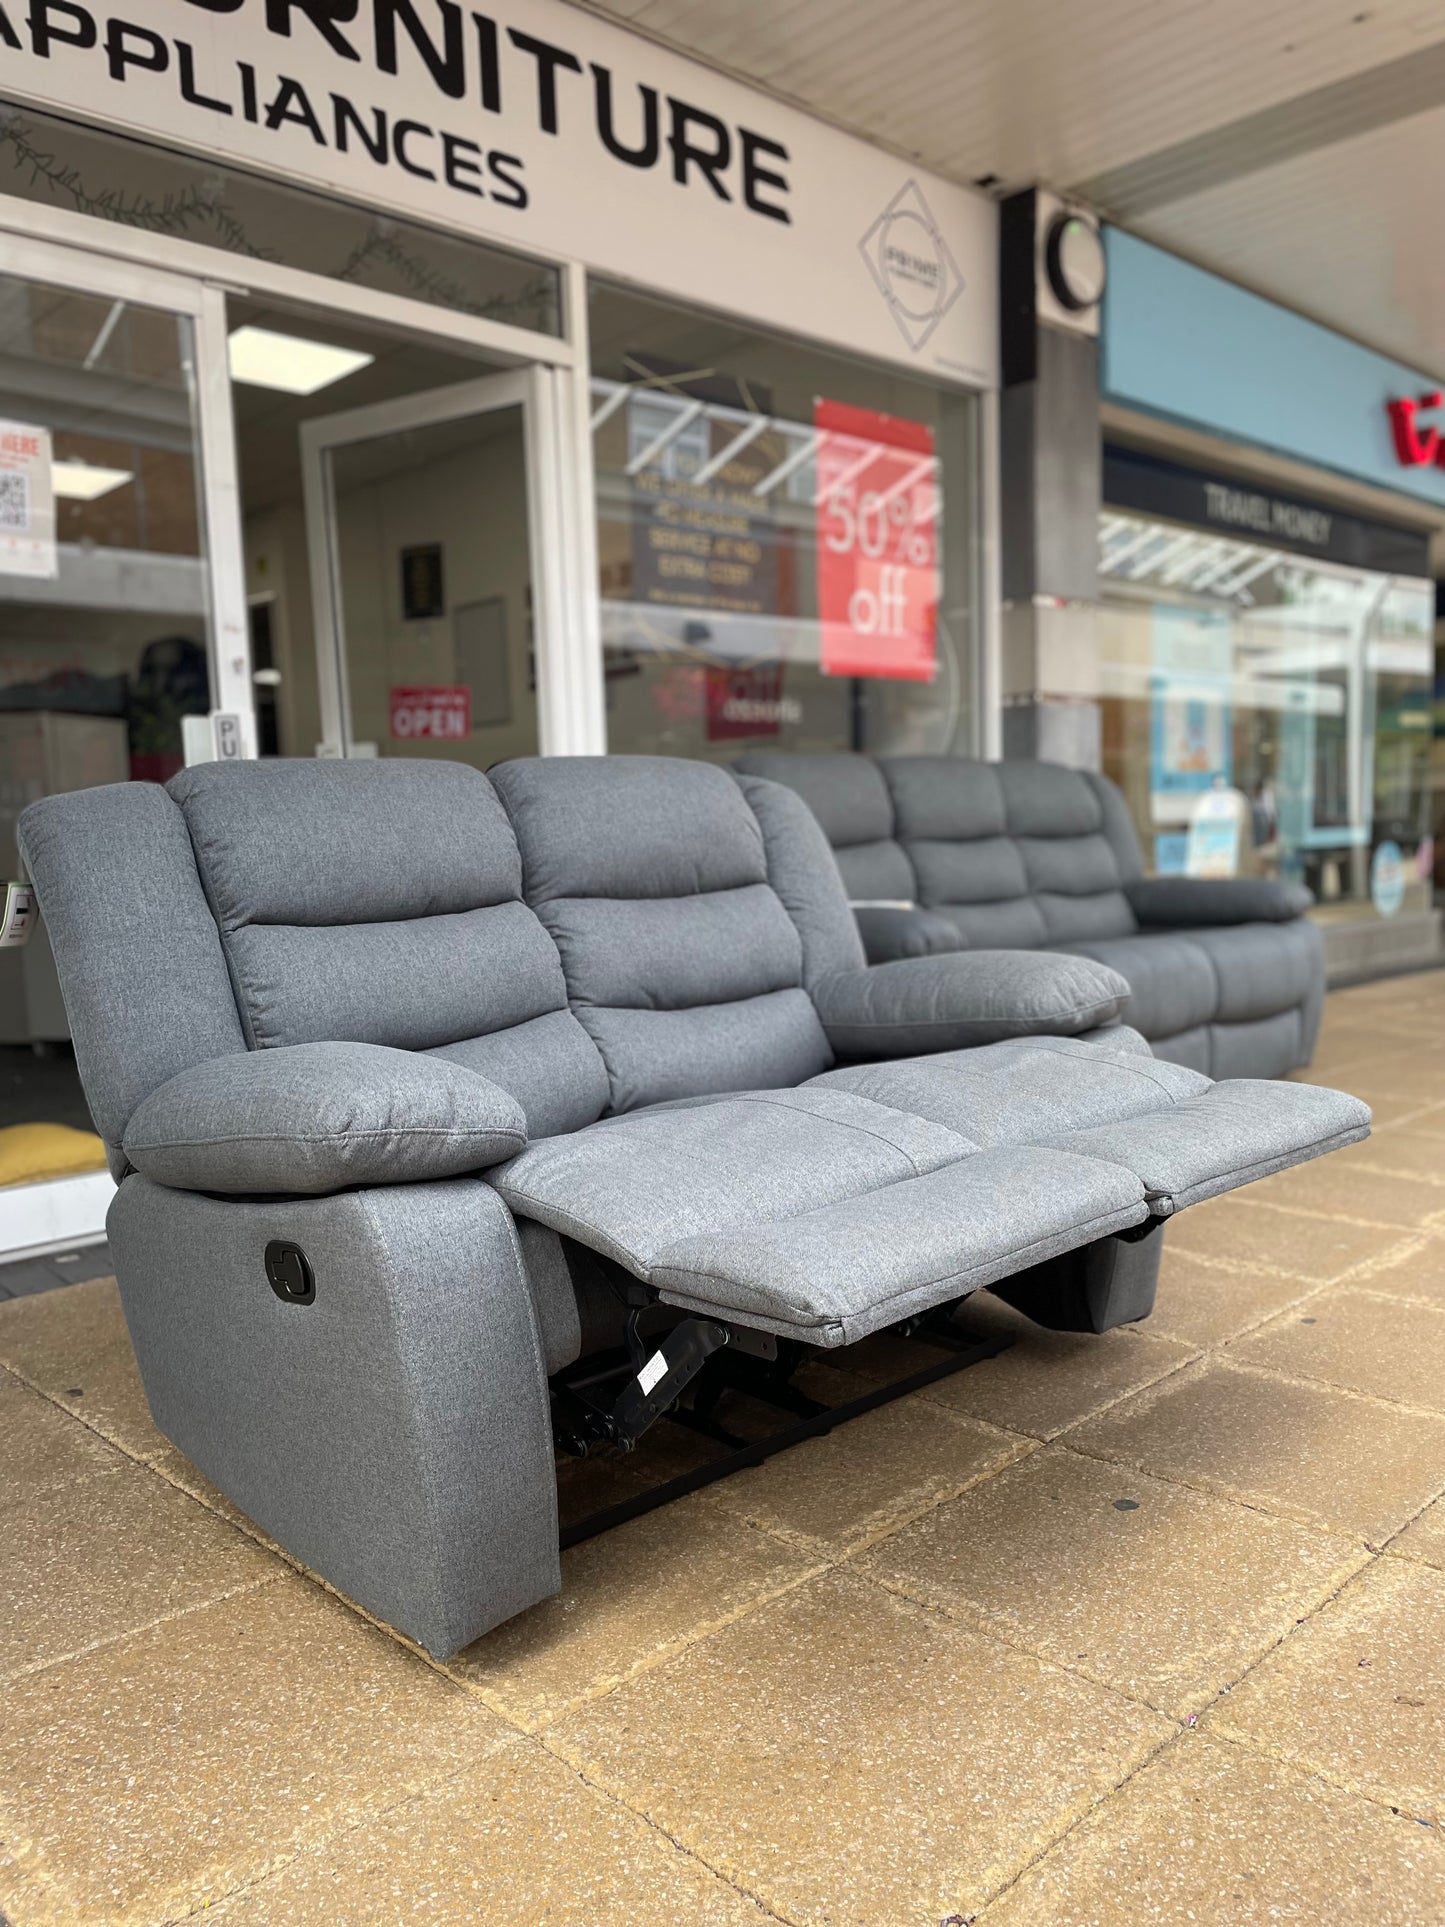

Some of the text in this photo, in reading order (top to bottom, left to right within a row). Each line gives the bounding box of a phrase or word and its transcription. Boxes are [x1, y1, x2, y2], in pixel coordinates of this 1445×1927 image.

[185, 0, 792, 226] RNITURE
[826, 487, 930, 566] 50%
[1203, 481, 1333, 547] TRAVEL MONEY
[849, 563, 908, 637] off
[394, 707, 465, 737] OPEN
